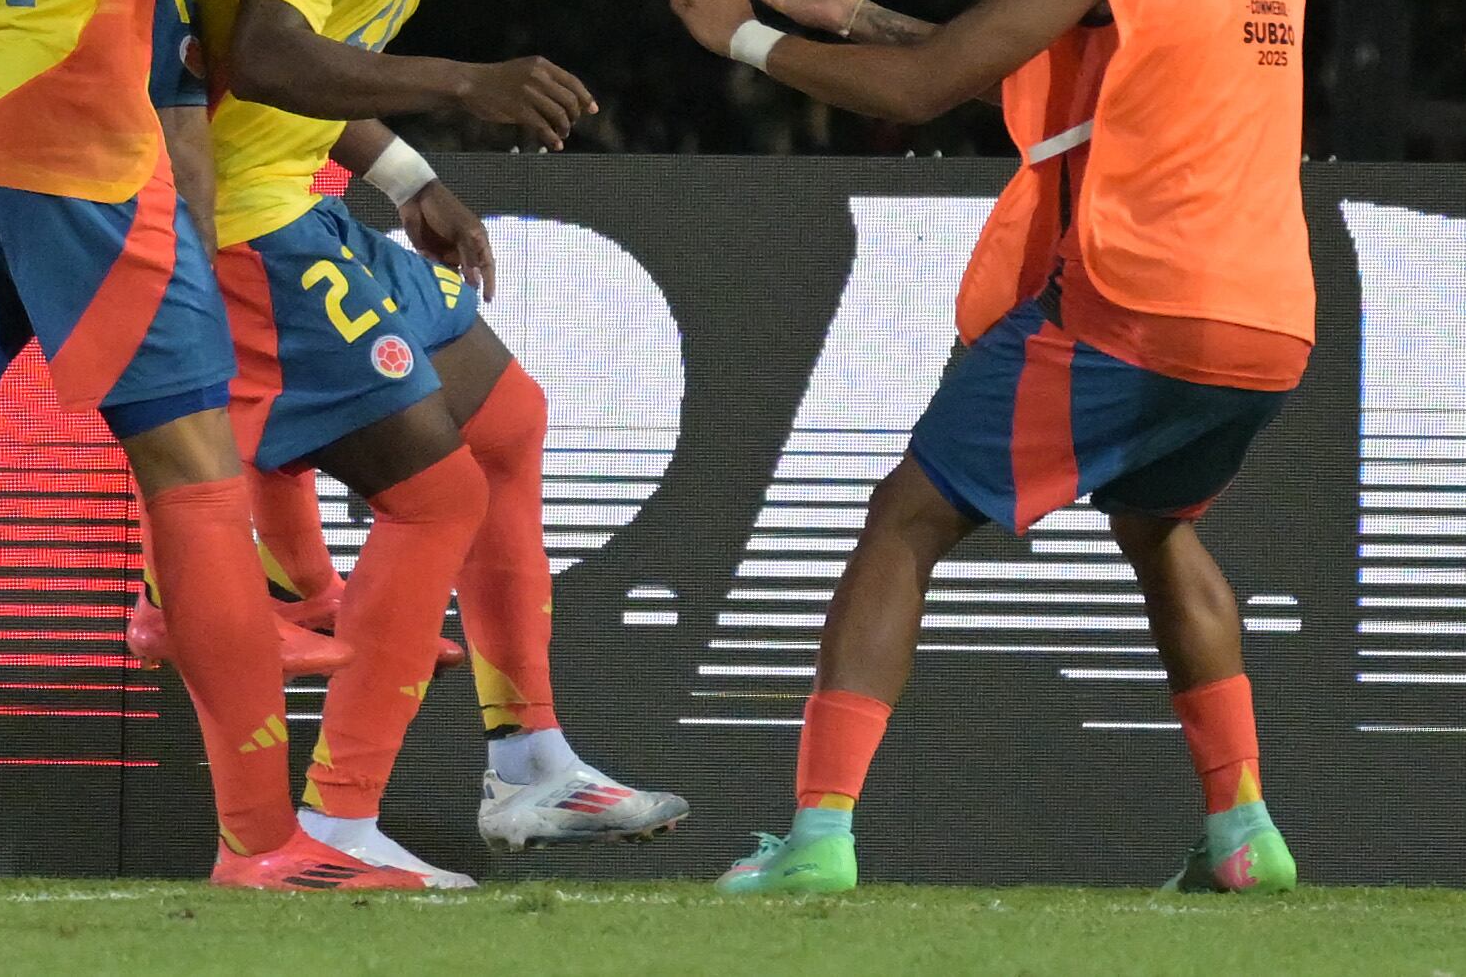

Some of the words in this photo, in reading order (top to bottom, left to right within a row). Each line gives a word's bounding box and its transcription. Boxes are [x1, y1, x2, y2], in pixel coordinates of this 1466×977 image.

[1243, 21, 1295, 46] SUB20
[1257, 50, 1288, 66] 2025
[301, 245, 398, 344] 2
